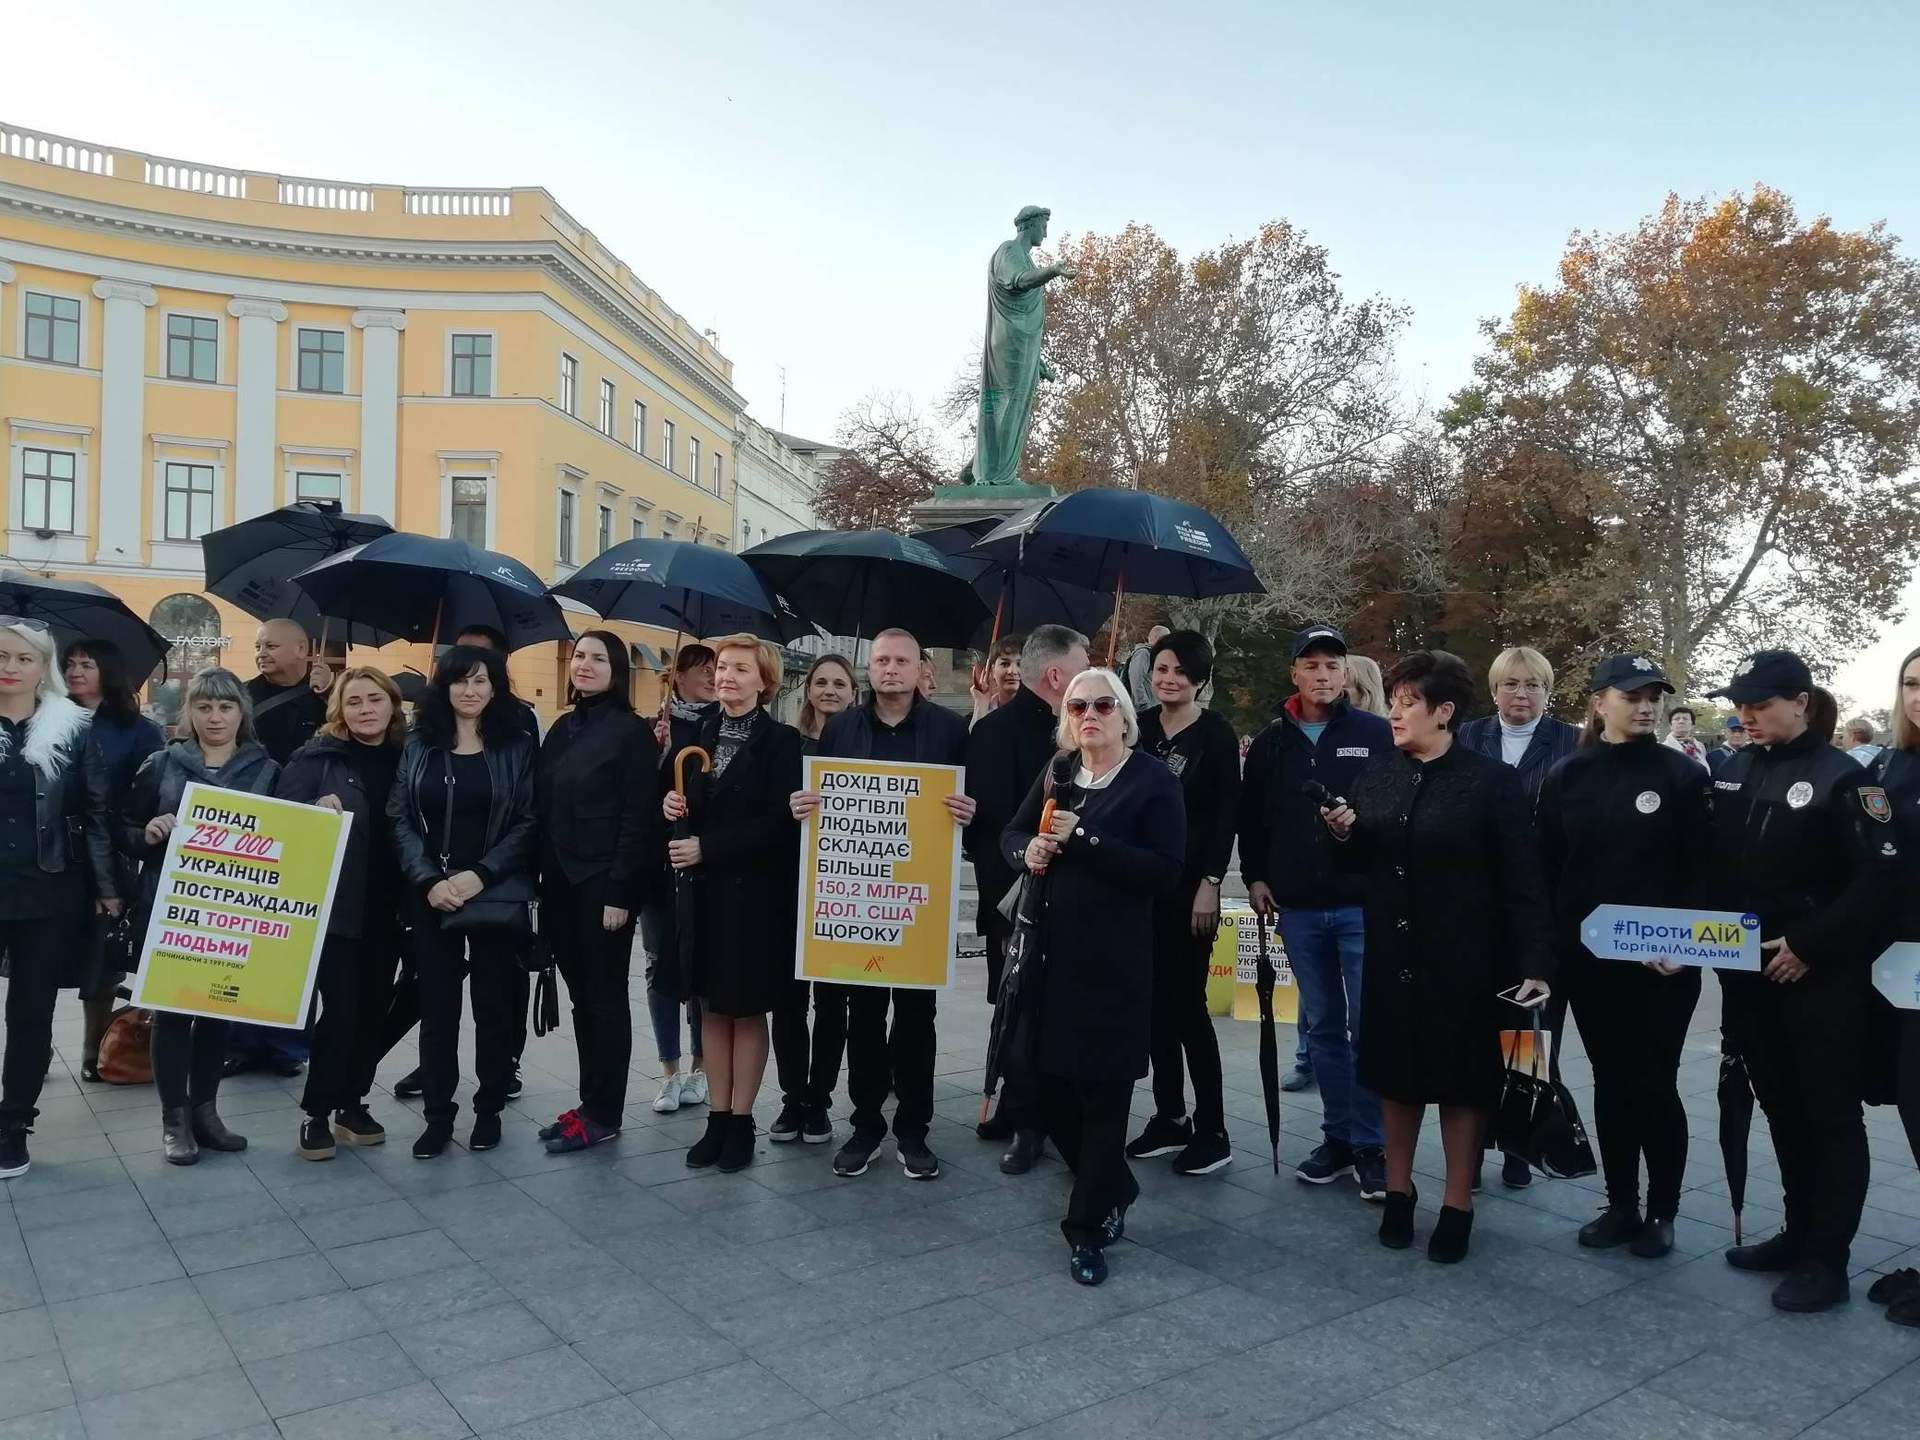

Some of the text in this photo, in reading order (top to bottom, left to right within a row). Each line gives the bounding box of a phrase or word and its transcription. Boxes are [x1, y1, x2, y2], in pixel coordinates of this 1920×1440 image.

[176, 635, 232, 647] FACTORY
[821, 773, 920, 796] ДОХІД ВІД
[821, 796, 904, 815] ТОРГІВЛІ
[192, 804, 257, 832] ПОНАД
[819, 816, 908, 836] ЛЮДЬМИ
[187, 824, 274, 855] 230 000
[818, 837, 910, 858] СКЛАДАЄ
[179, 855, 280, 885] УКРАЇНЦІВ
[817, 859, 892, 878] БІЛЬШЕ
[173, 881, 318, 917] ПОСТРАЖДАЛИ
[817, 880, 928, 904] 150,2 МЛРД.
[815, 901, 913, 921] ДОЛ. США
[167, 906, 290, 939] ВІД ТОРГІВЛІ
[815, 922, 900, 942] ЩОРОКУ
[1613, 920, 1692, 940] #Проти
[160, 931, 249, 958] ЛЮДЬМИ
[1238, 931, 1271, 941] СЕРД
[156, 951, 202, 963] ПОЧИНАЮЧИ
[226, 962, 245, 970] РОКУ
